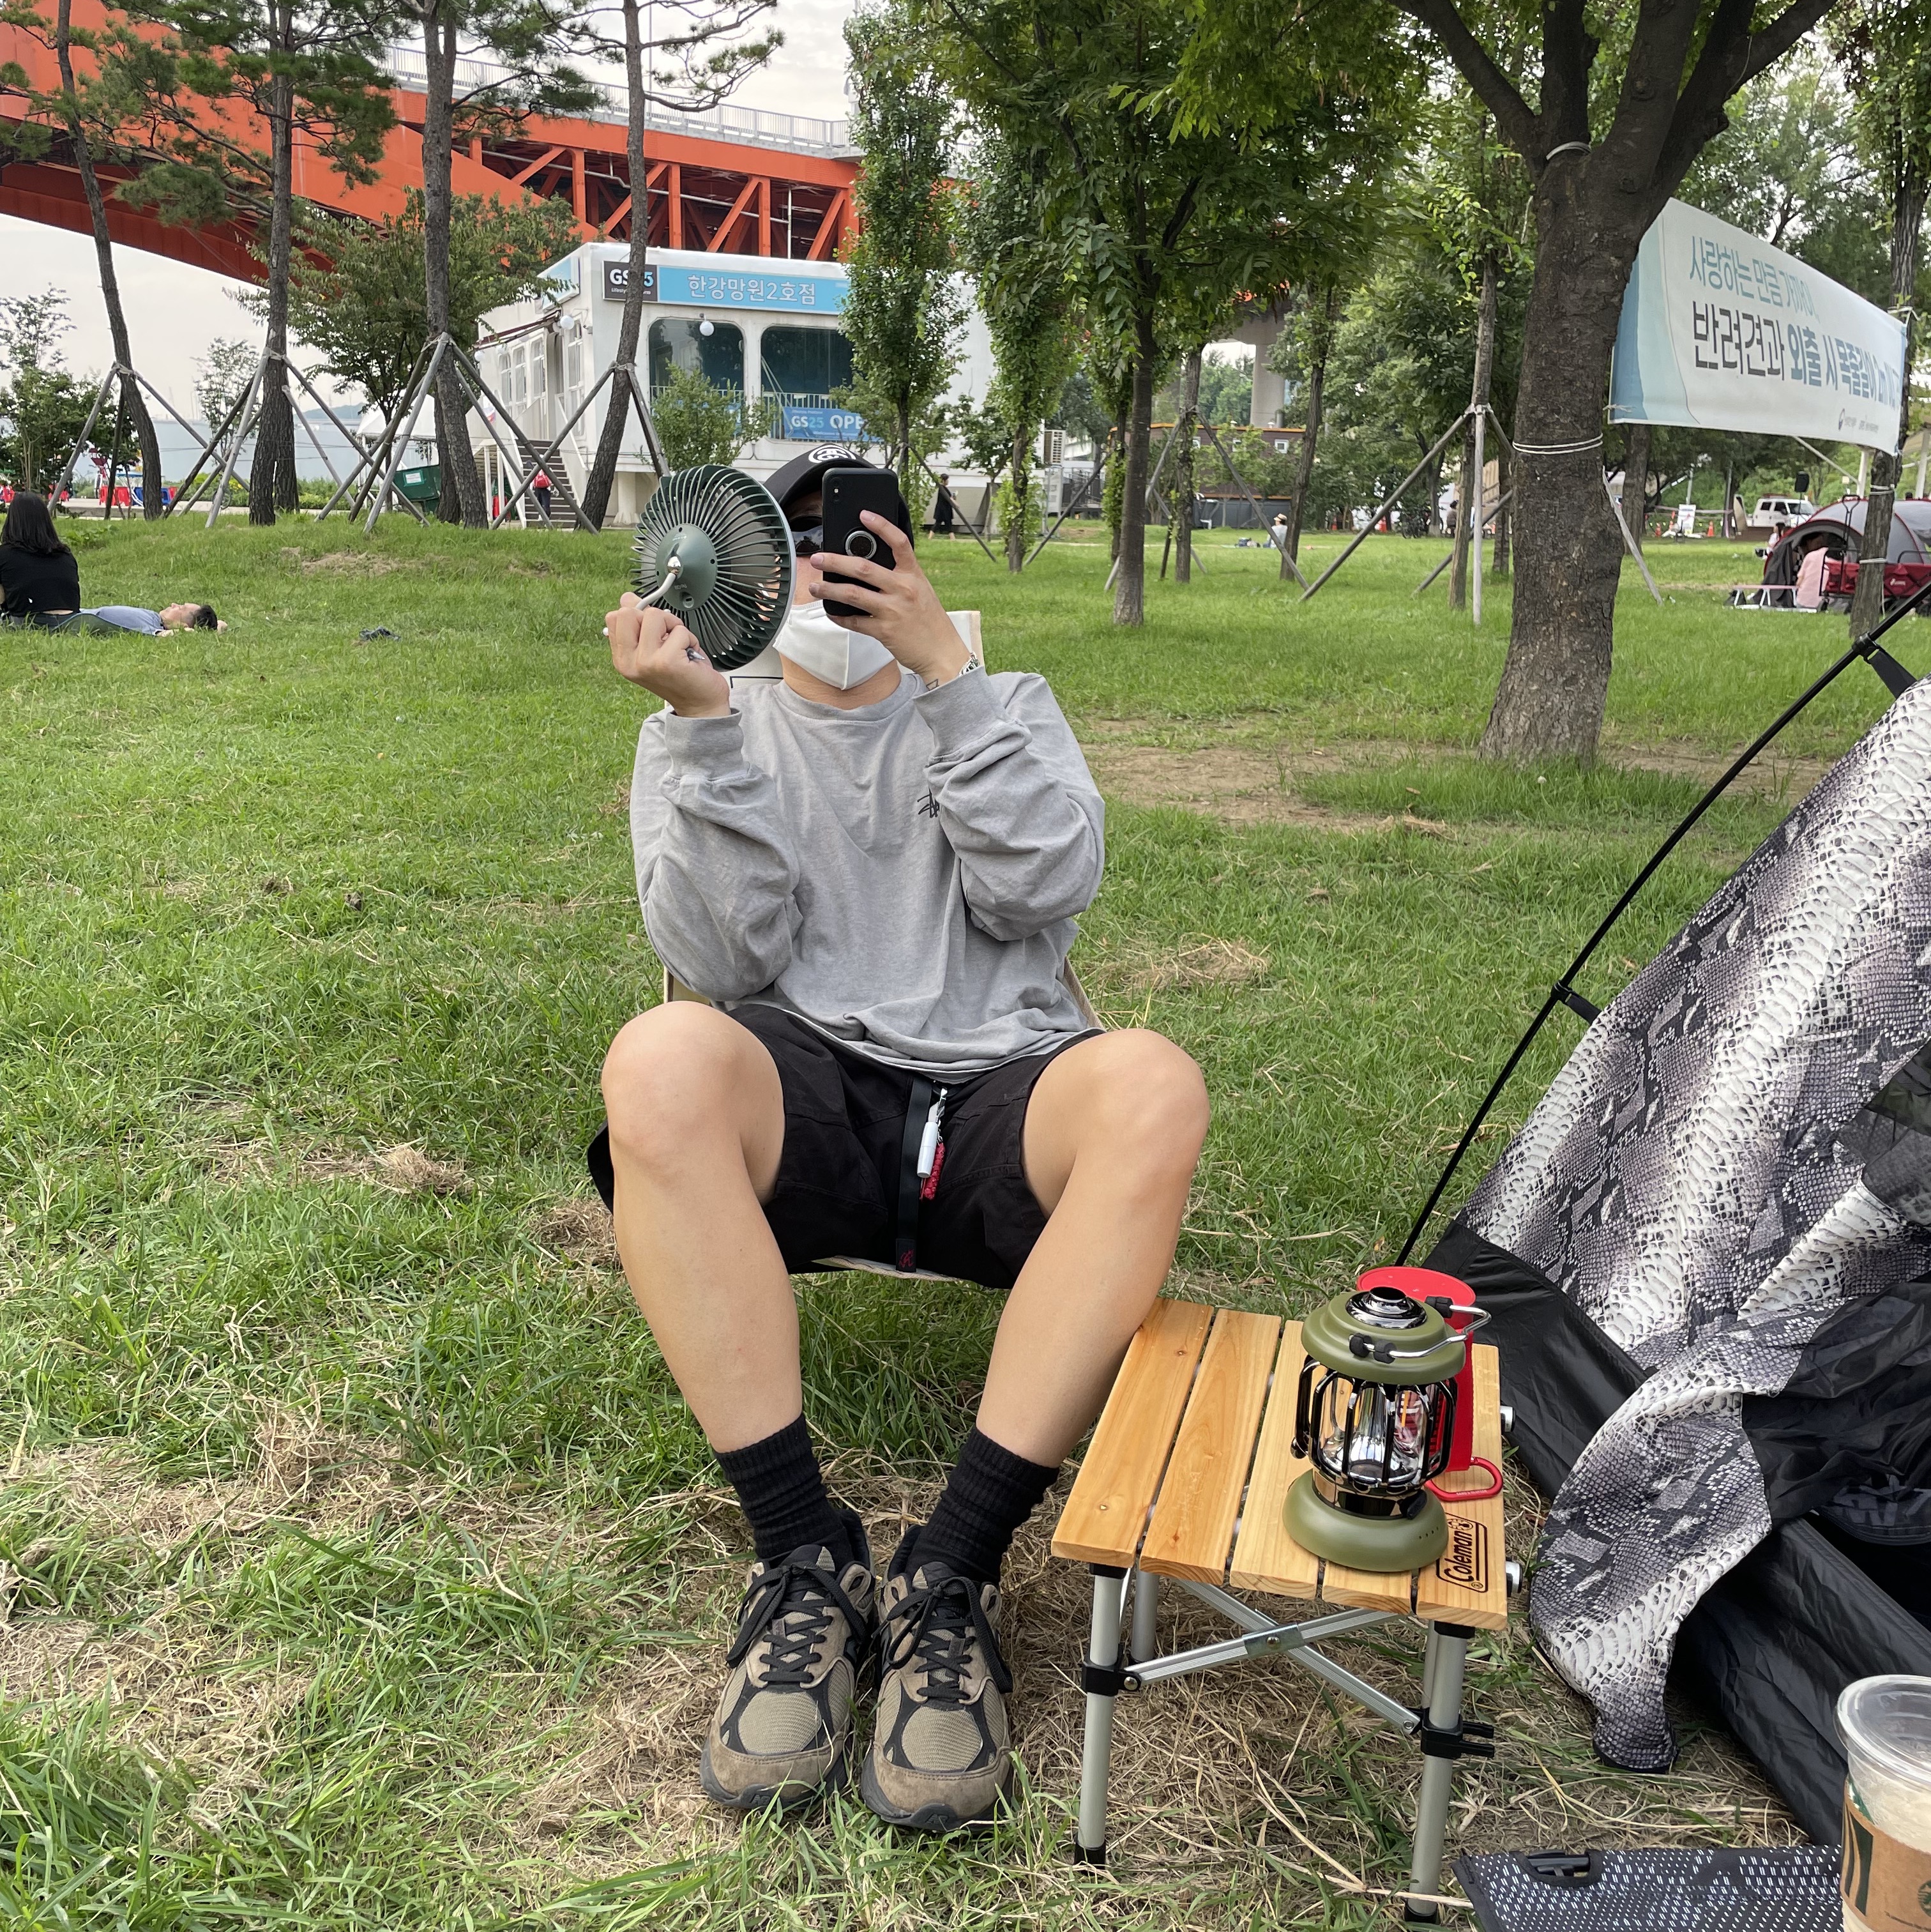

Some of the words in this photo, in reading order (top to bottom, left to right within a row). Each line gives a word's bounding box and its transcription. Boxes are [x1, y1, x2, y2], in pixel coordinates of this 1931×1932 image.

[609, 268, 654, 287] GS5
[687, 274, 815, 306] 한강망원2호점
[1690, 236, 1754, 300] 사랑하는
[1752, 258, 1783, 307] 만큼
[1692, 300, 1785, 381] 반려견과
[1787, 323, 1822, 388] 외출
[791, 415, 824, 429] GS25
[829, 415, 865, 430] OPE
[1443, 1530, 1475, 1582] Coleman
